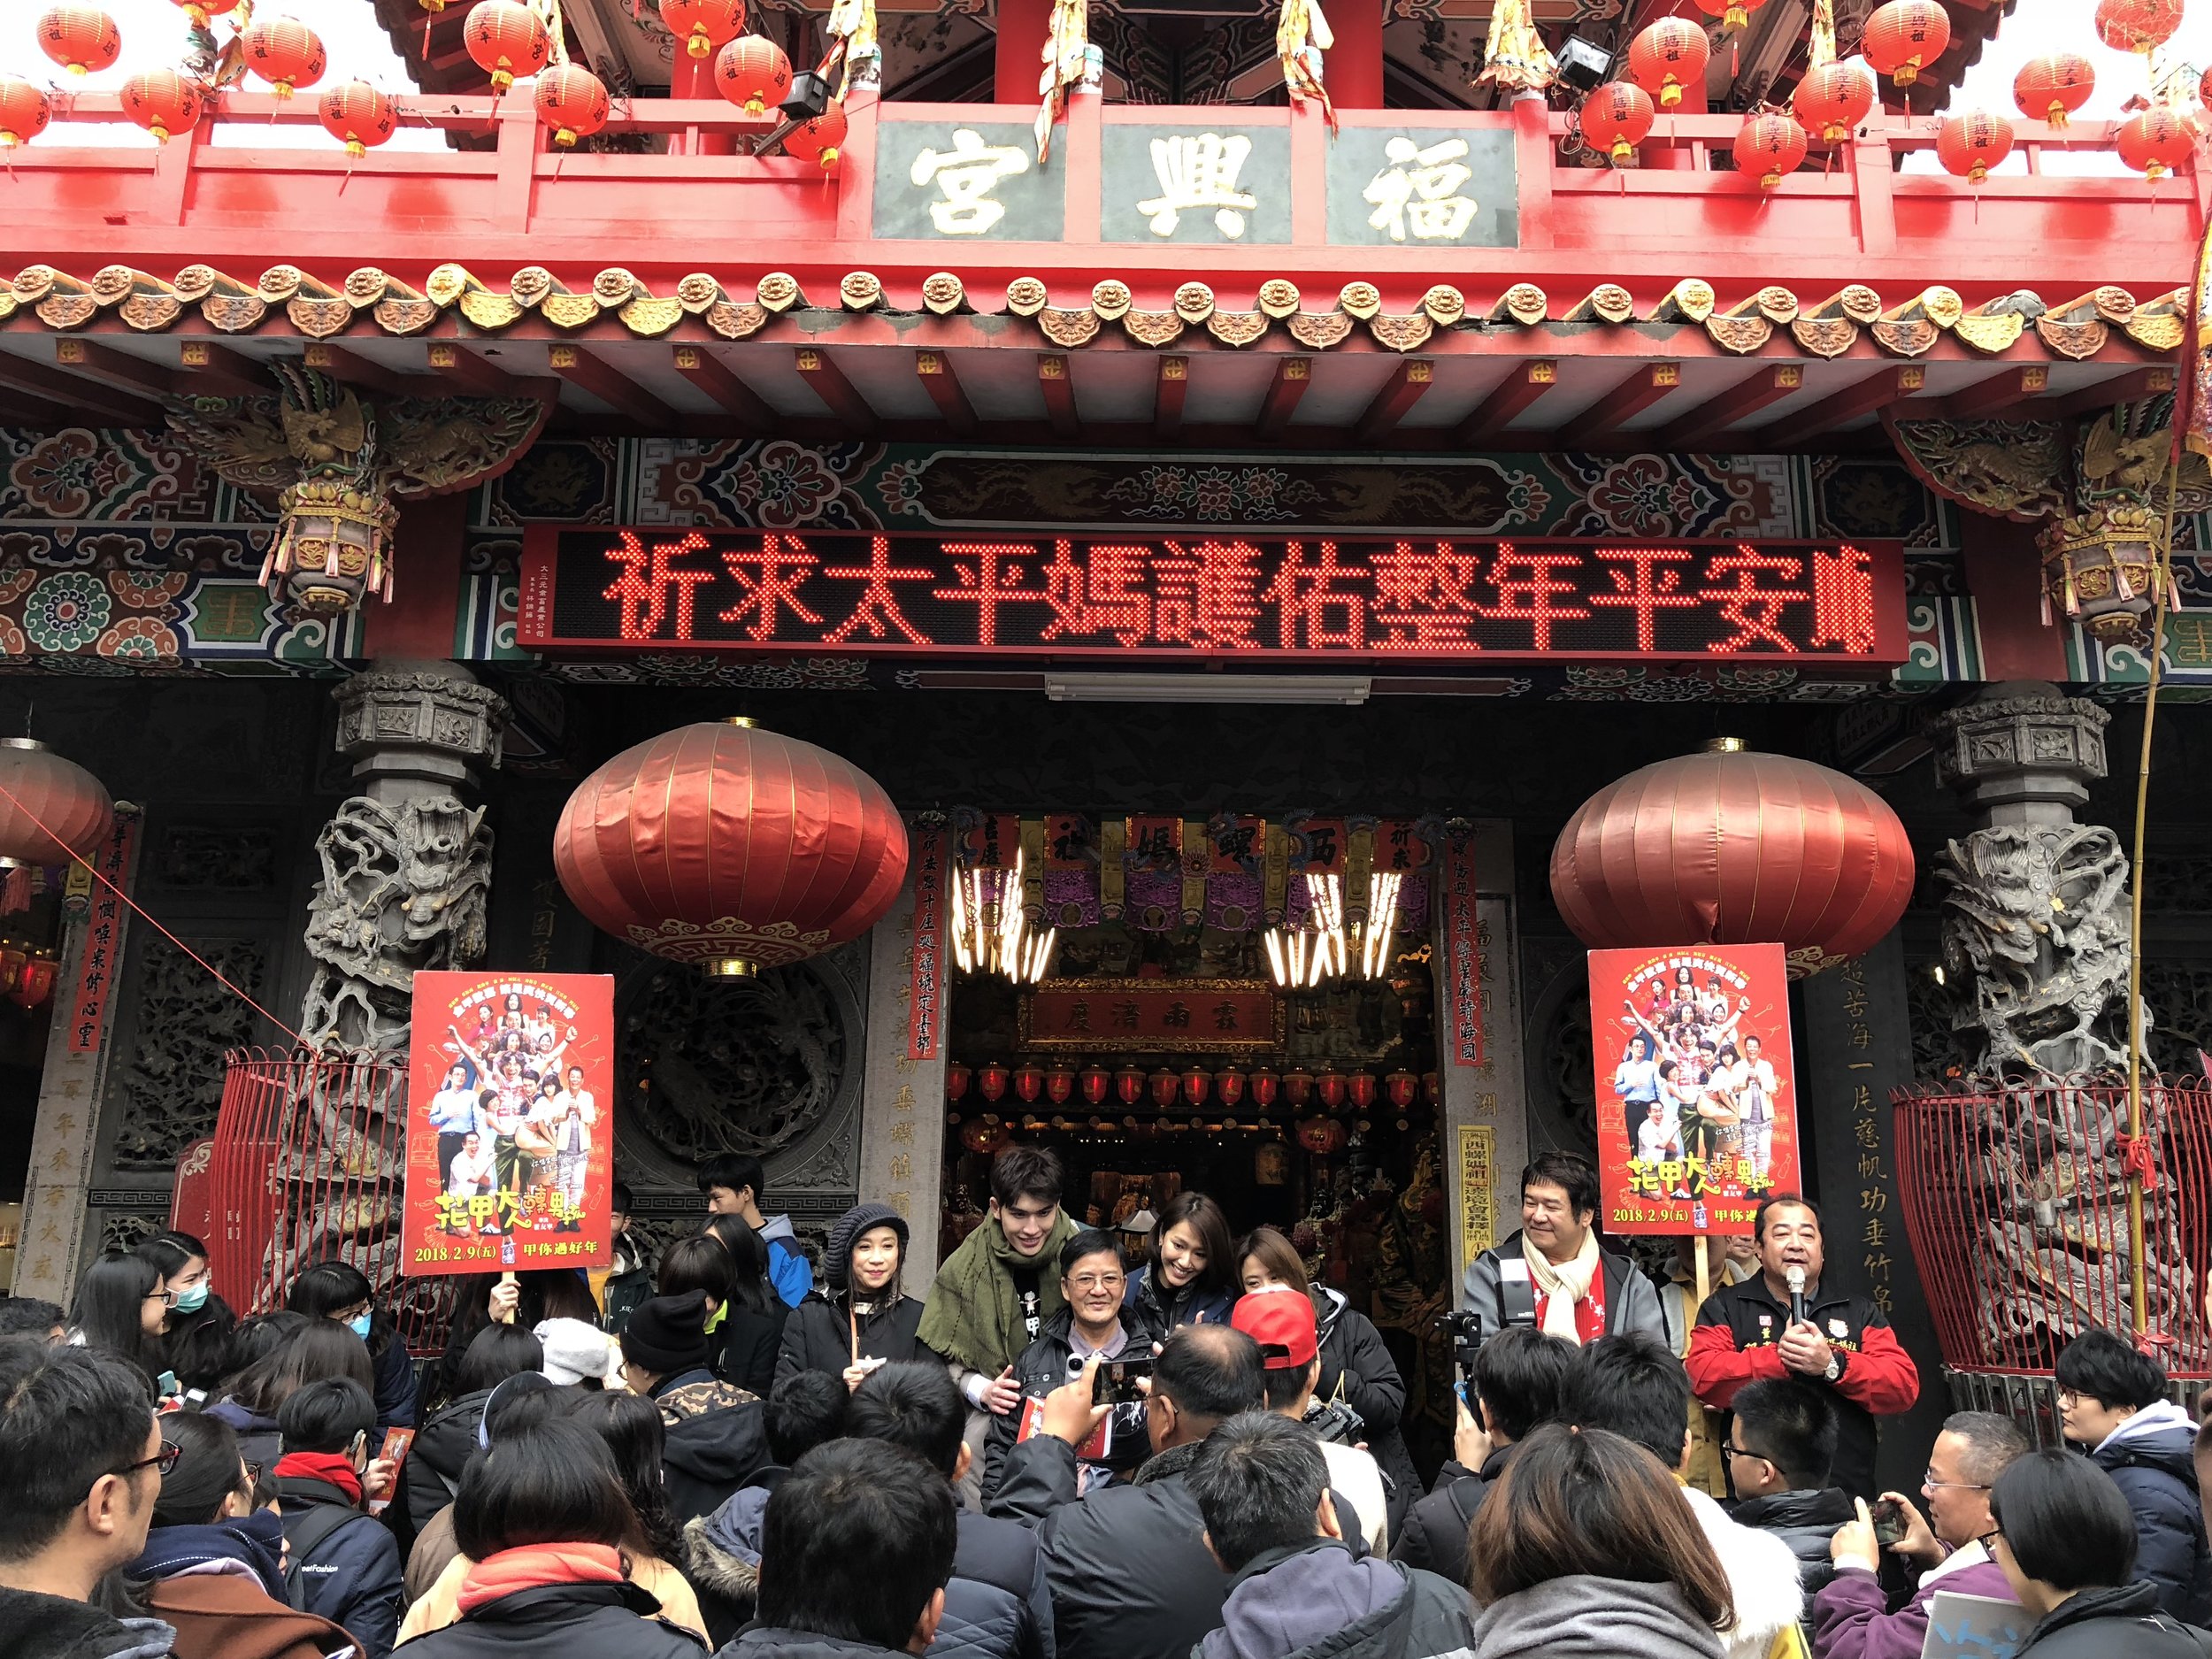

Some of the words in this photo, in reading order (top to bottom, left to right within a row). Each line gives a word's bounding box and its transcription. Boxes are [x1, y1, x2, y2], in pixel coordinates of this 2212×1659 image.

[910, 128, 1479, 241] 福興宮
[414, 1245, 496, 1262] 2018/2/9(五)
